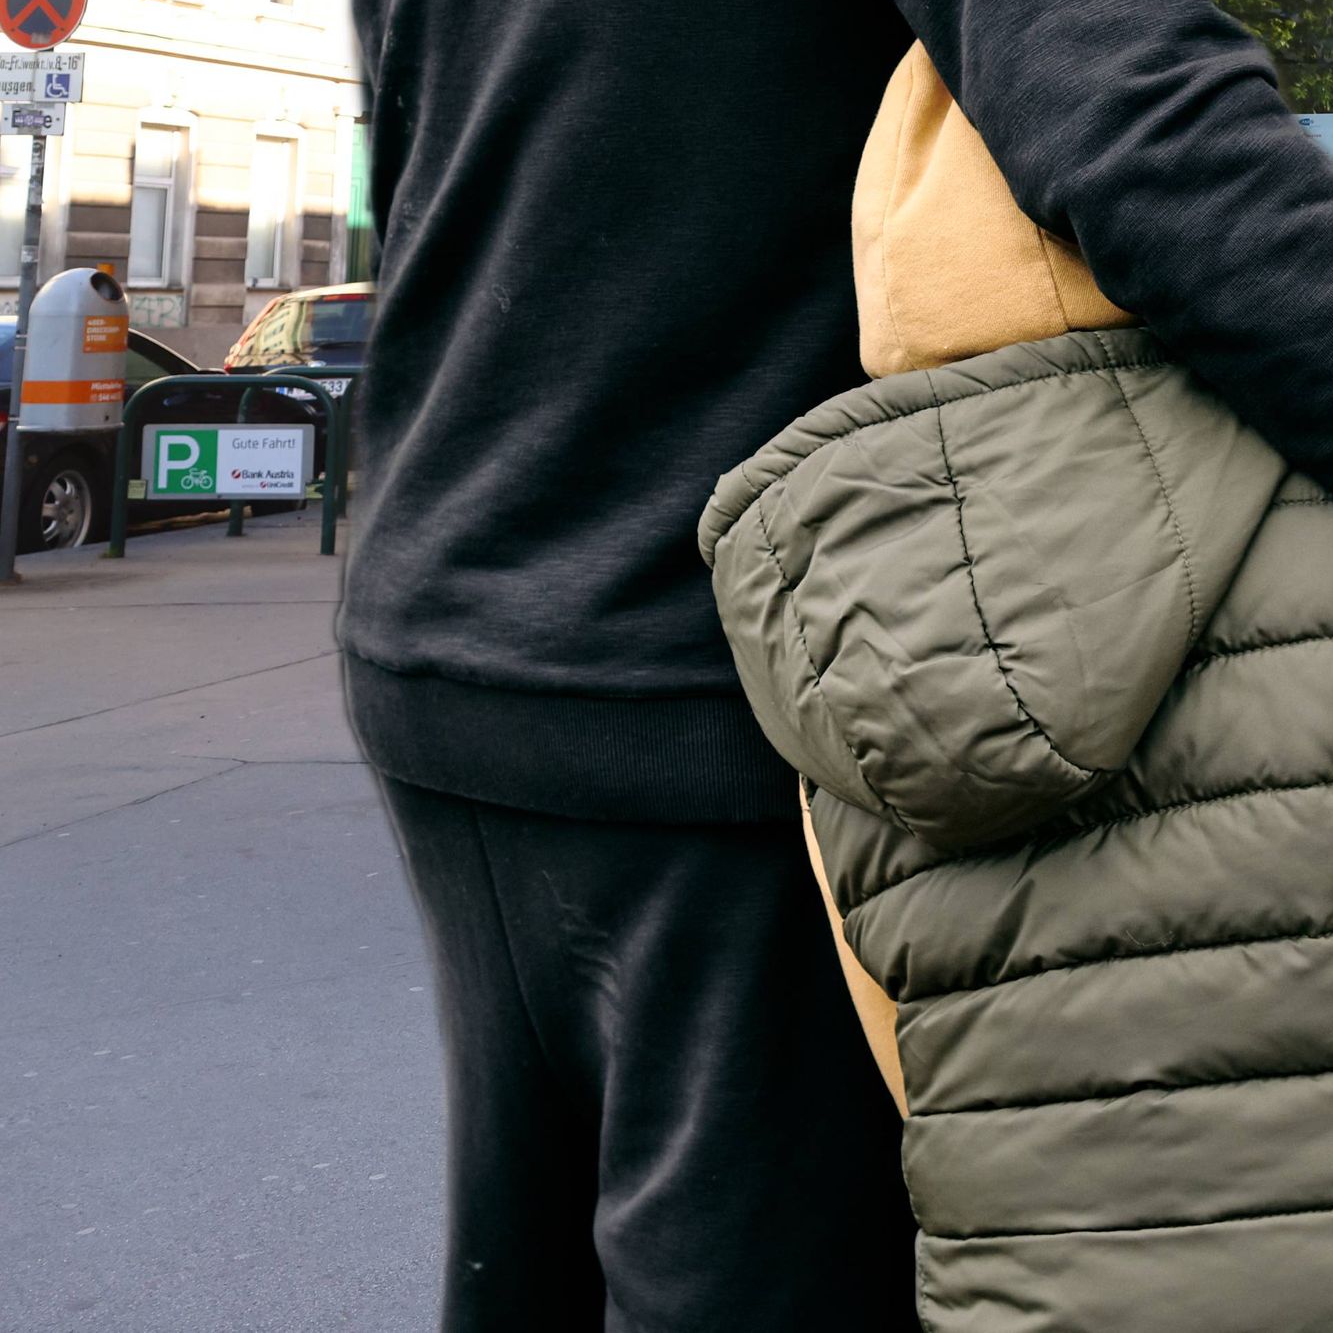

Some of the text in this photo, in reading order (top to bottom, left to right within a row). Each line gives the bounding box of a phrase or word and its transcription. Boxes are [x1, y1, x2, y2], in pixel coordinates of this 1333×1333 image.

[0, 81, 36, 95] usgen.
[232, 437, 295, 449] Gute Fahrt!
[242, 470, 294, 479] Bank Austria
